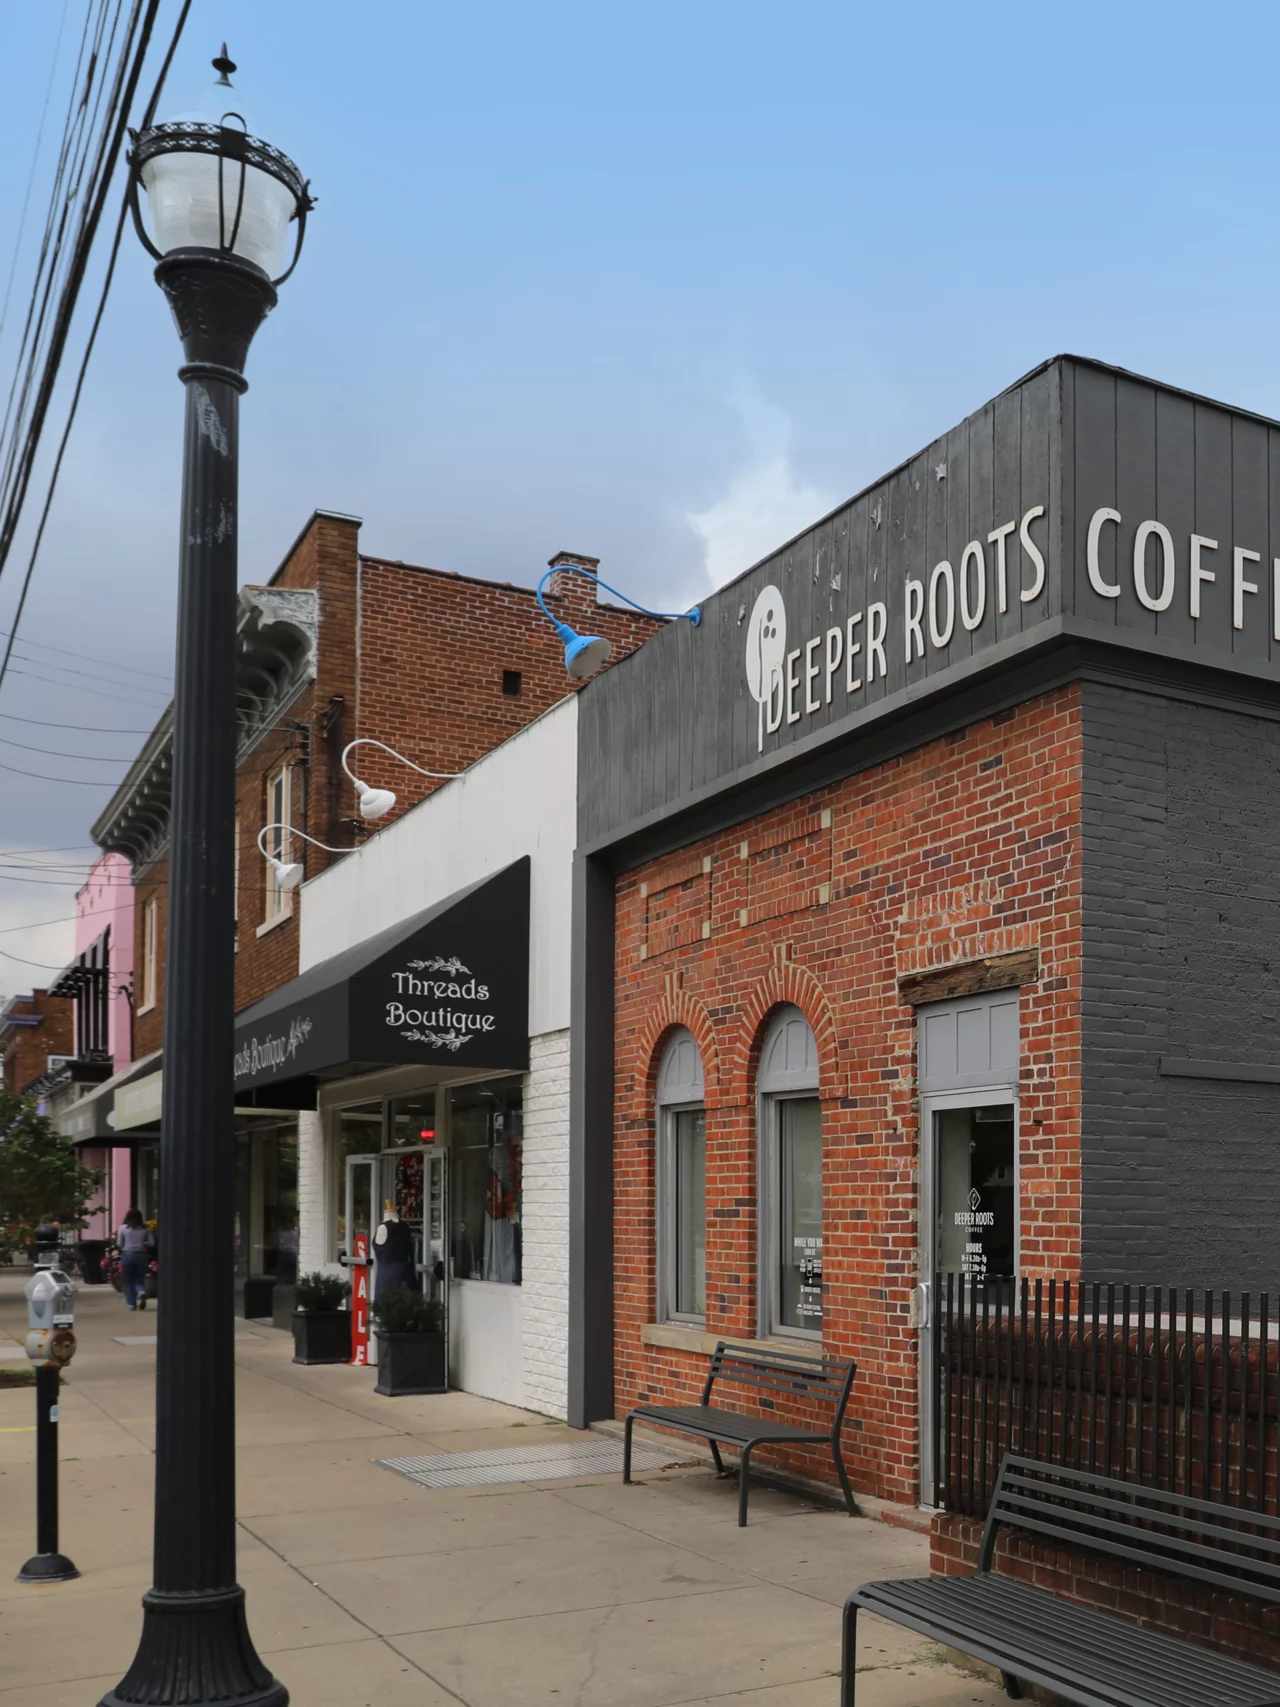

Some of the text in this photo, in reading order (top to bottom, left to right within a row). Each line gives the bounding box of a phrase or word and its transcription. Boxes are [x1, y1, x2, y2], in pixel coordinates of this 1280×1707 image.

[766, 505, 1045, 734] DEEPER ROOTS
[391, 972, 490, 1000] Threads
[385, 1002, 496, 1034] Boutique
[251, 1037, 286, 1074] Boutique
[954, 1212, 994, 1226] DEEPER ROOTS
[964, 1226, 983, 1234] COFFEE
[965, 1243, 983, 1253] HOURS
[352, 1241, 367, 1366] SALE
